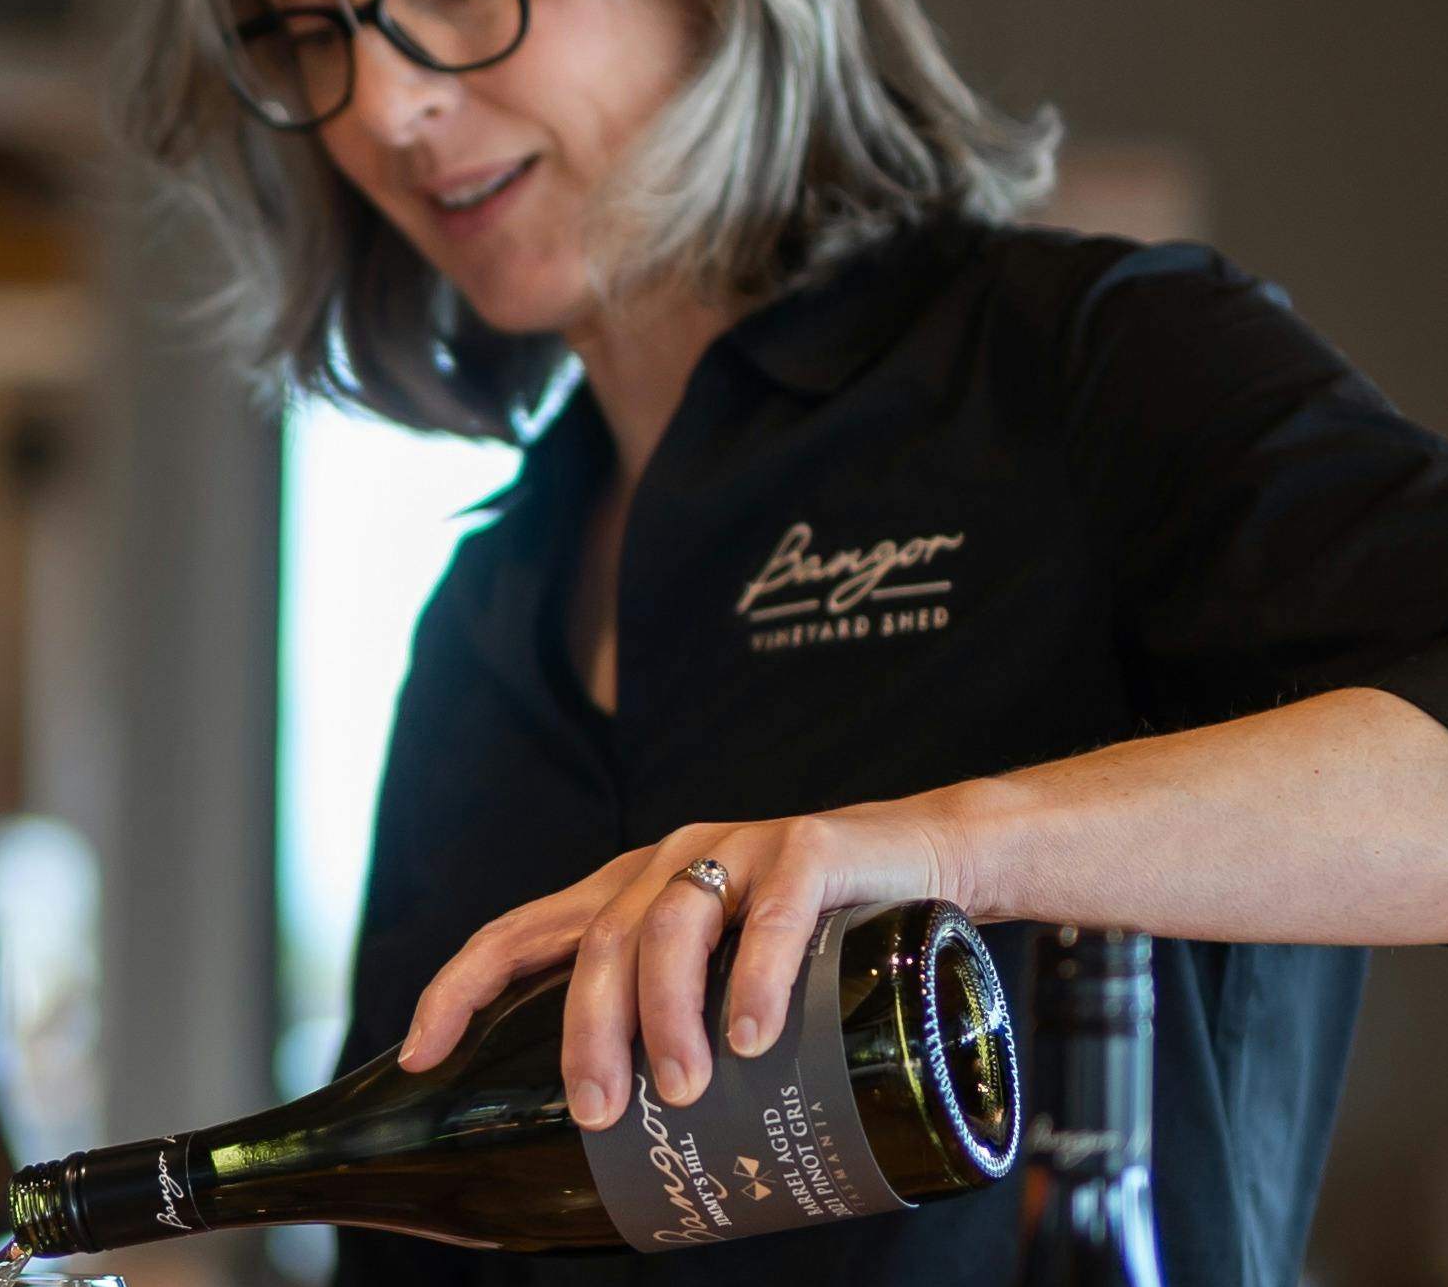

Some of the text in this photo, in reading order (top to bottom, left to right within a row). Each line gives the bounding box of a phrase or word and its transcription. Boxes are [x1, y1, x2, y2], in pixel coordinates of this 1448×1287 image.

[736, 521, 964, 614] Bangor
[752, 606, 950, 650] VINEYARD SHED
[156, 1151, 192, 1230] Bangor
[635, 1072, 728, 1244] Bangor
[680, 1132, 733, 1227] JIMMY'S HILL
[763, 1108, 824, 1217] BARREL AGED
[781, 1085, 854, 1217] 2021 PINOT GRIS
[810, 1100, 866, 1208] TASMANIA
